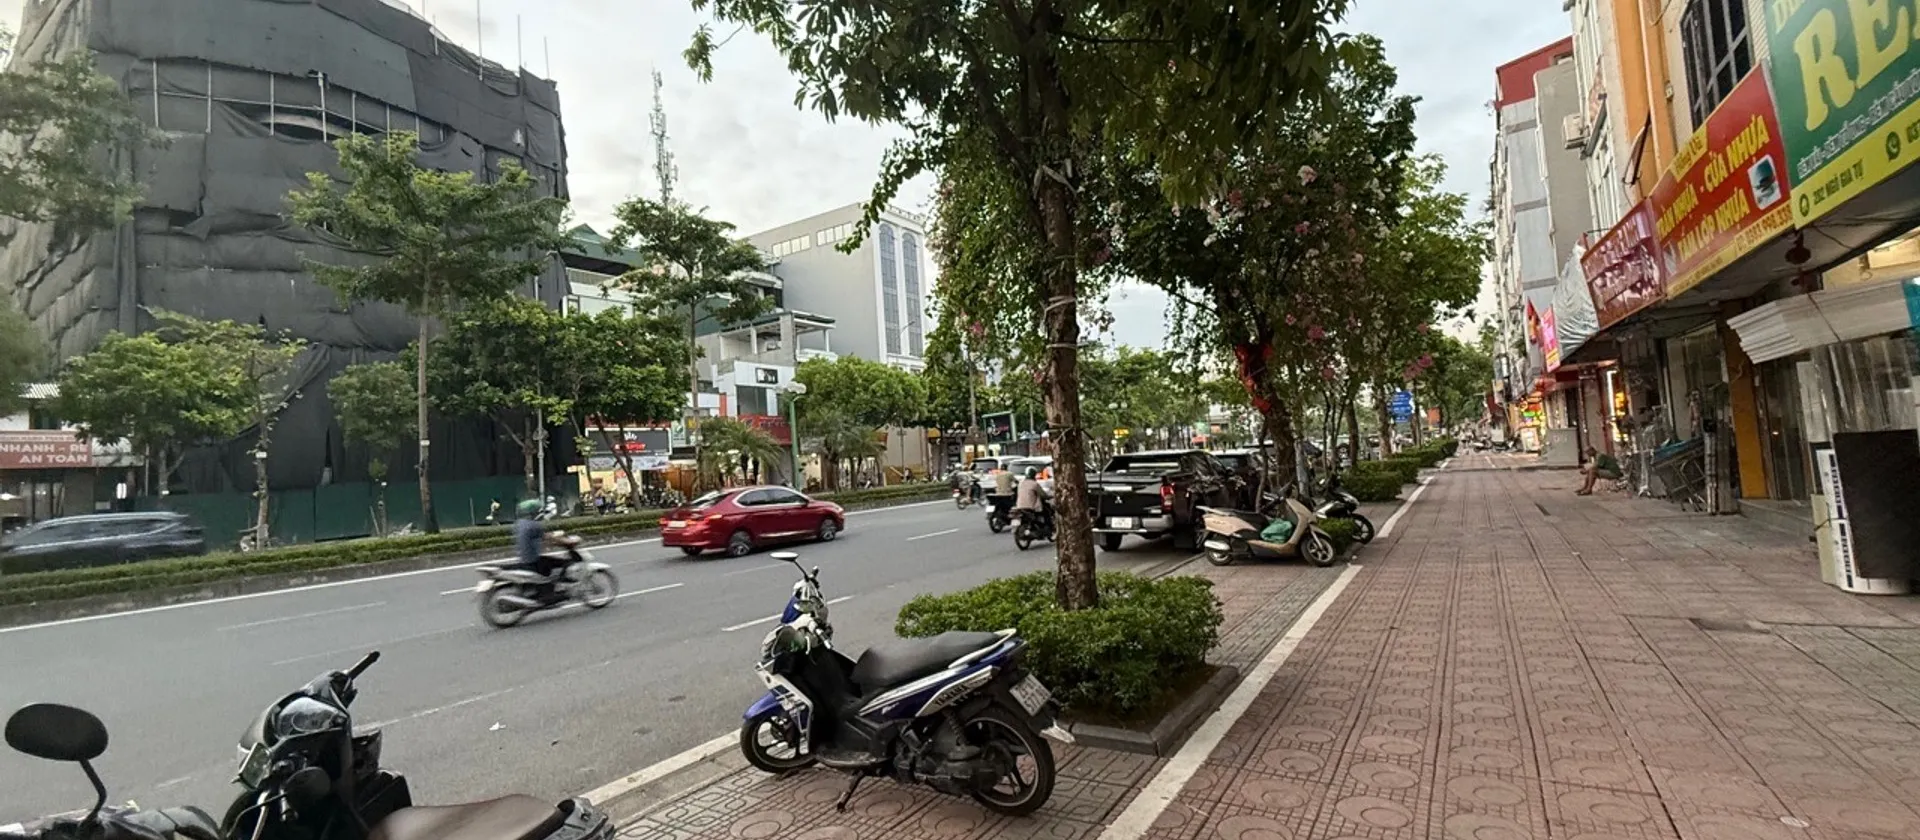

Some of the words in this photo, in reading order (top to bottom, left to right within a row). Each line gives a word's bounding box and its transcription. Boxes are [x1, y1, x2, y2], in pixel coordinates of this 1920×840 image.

[1794, 0, 1920, 131] RE
[1726, 114, 1770, 174] NHỰA
[1714, 186, 1750, 234] NHỰA
[19, 454, 42, 464] AN
